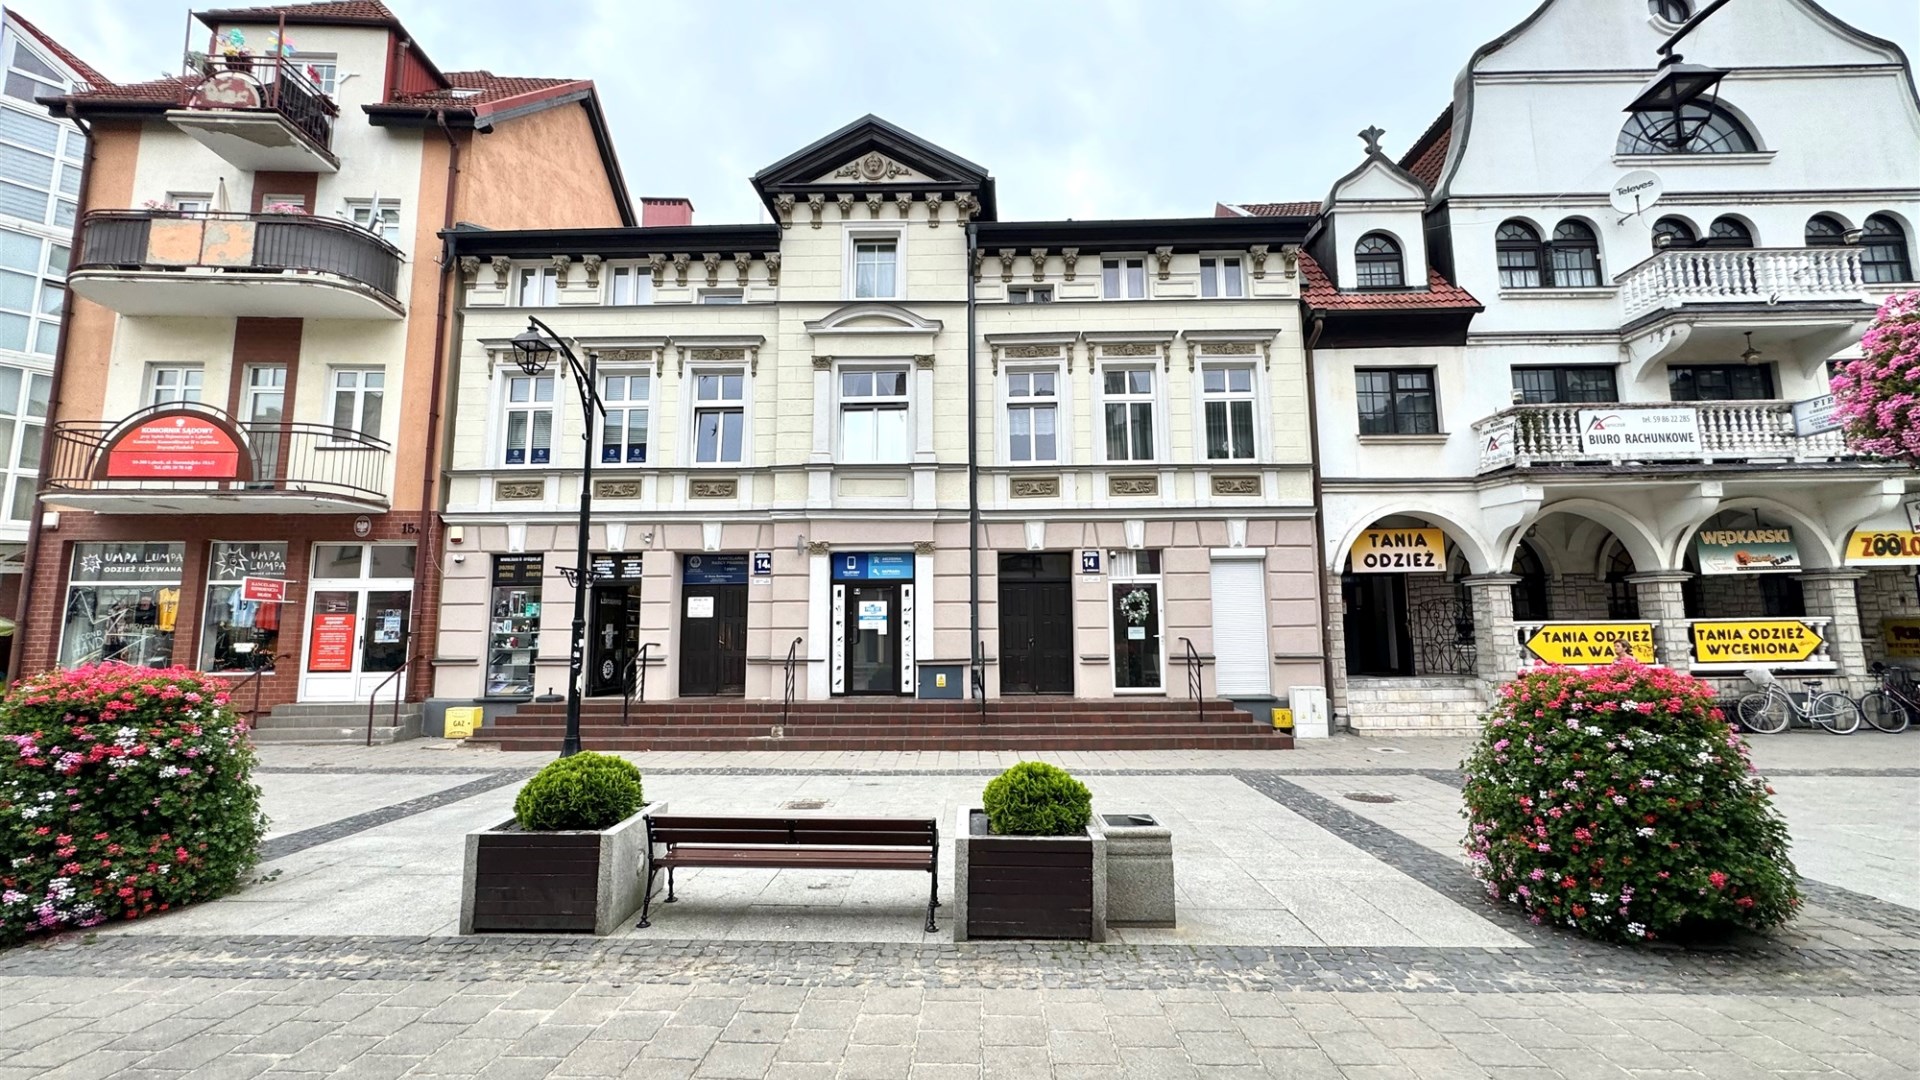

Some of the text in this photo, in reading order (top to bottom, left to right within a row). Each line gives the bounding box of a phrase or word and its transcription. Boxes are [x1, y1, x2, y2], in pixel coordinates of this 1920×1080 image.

[1616, 180, 1654, 196] Televes
[1679, 415, 1690, 423] 285
[182, 427, 214, 435] SĄDOWY
[1588, 432, 1695, 445] BIURO RACHUNKOWE
[1368, 533, 1428, 548] TANIA
[1700, 529, 1790, 547] WĘDKARSKI
[105, 552, 184, 563] UMPA LUMPA
[250, 551, 282, 560] UMPA
[1363, 550, 1435, 568] ODZIEŻ
[250, 561, 287, 571] LUMPA
[1083, 557, 1095, 567] 14
[103, 565, 183, 573] ODZIEŻ UŻYWANA
[1542, 628, 1651, 643] TANIA ODZIEŻ
[1697, 625, 1805, 641] TANIA ODZIEŻ
[1562, 646, 1583, 657] NA
[1706, 642, 1800, 655] WYCENIONA
